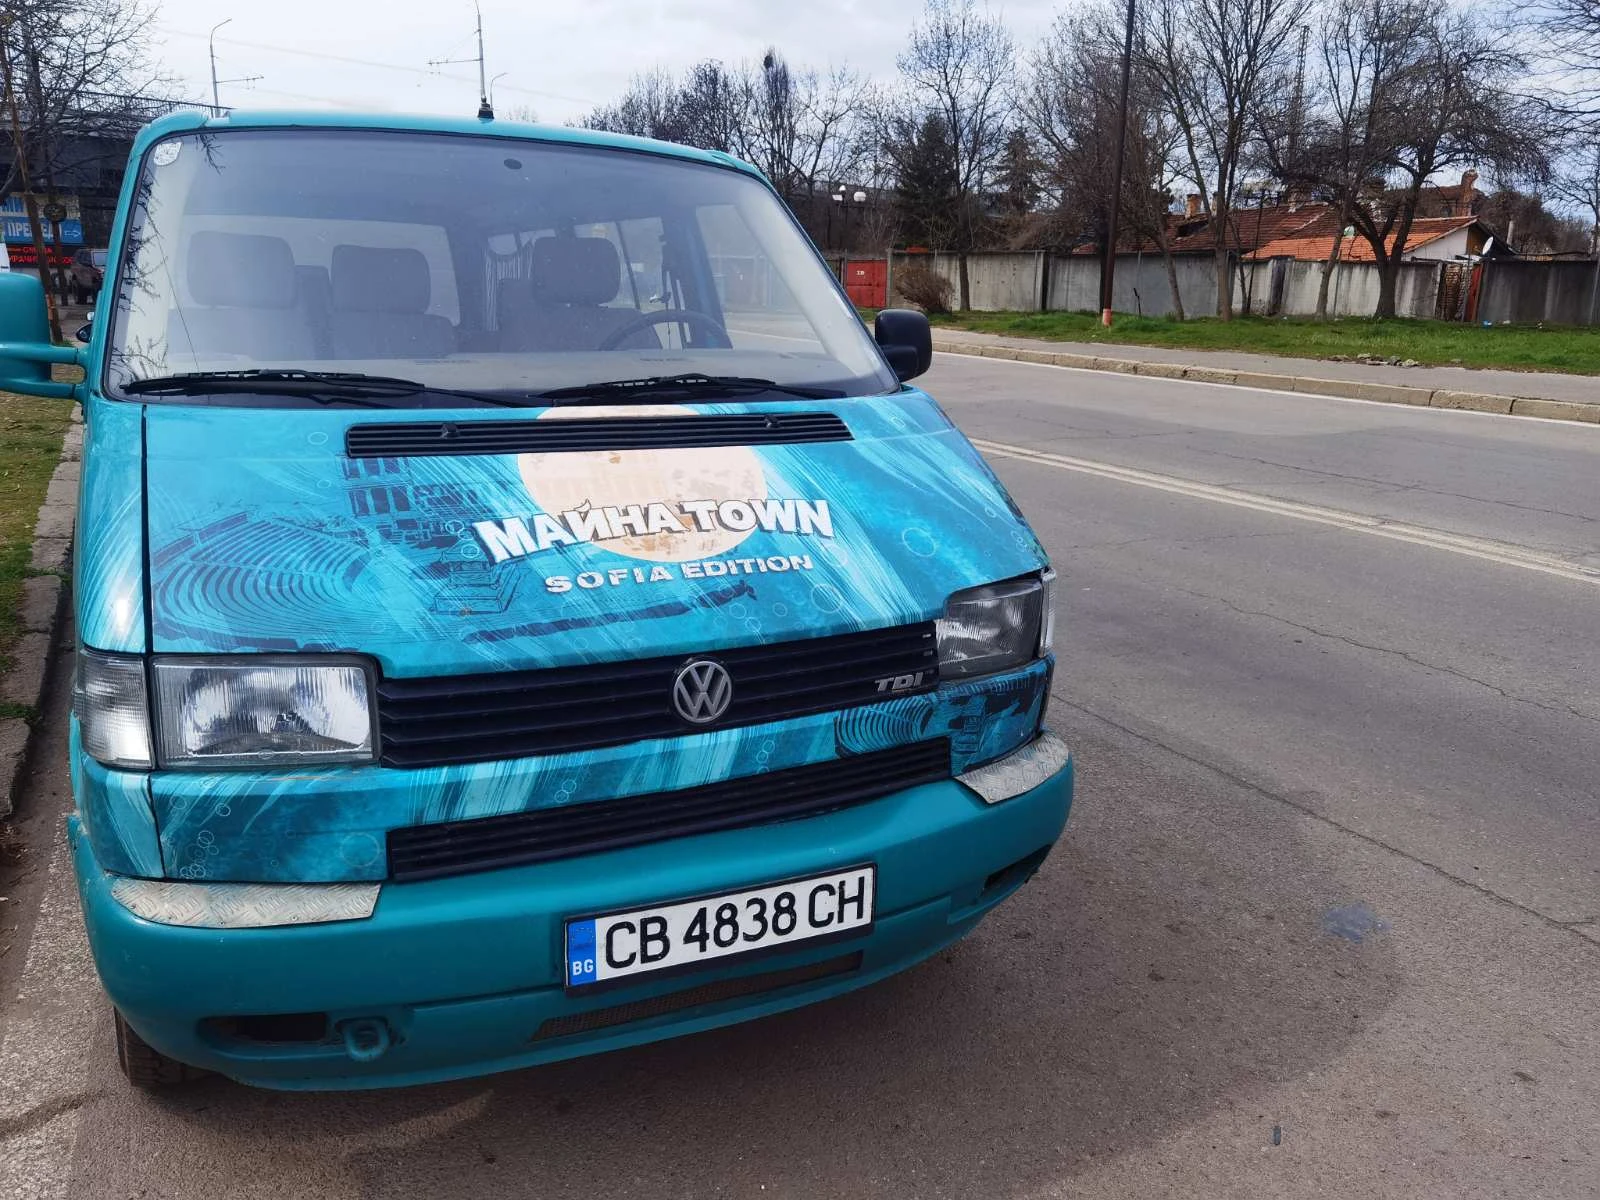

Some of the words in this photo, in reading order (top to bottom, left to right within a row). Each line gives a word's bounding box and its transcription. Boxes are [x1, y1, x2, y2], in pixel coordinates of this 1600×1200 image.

[680, 499, 835, 538] TOWN
[545, 566, 674, 593] SOFIA
[681, 555, 814, 579] EDITION
[874, 672, 924, 692] TDI
[682, 891, 797, 952] 4838
[572, 958, 595, 976] BG
